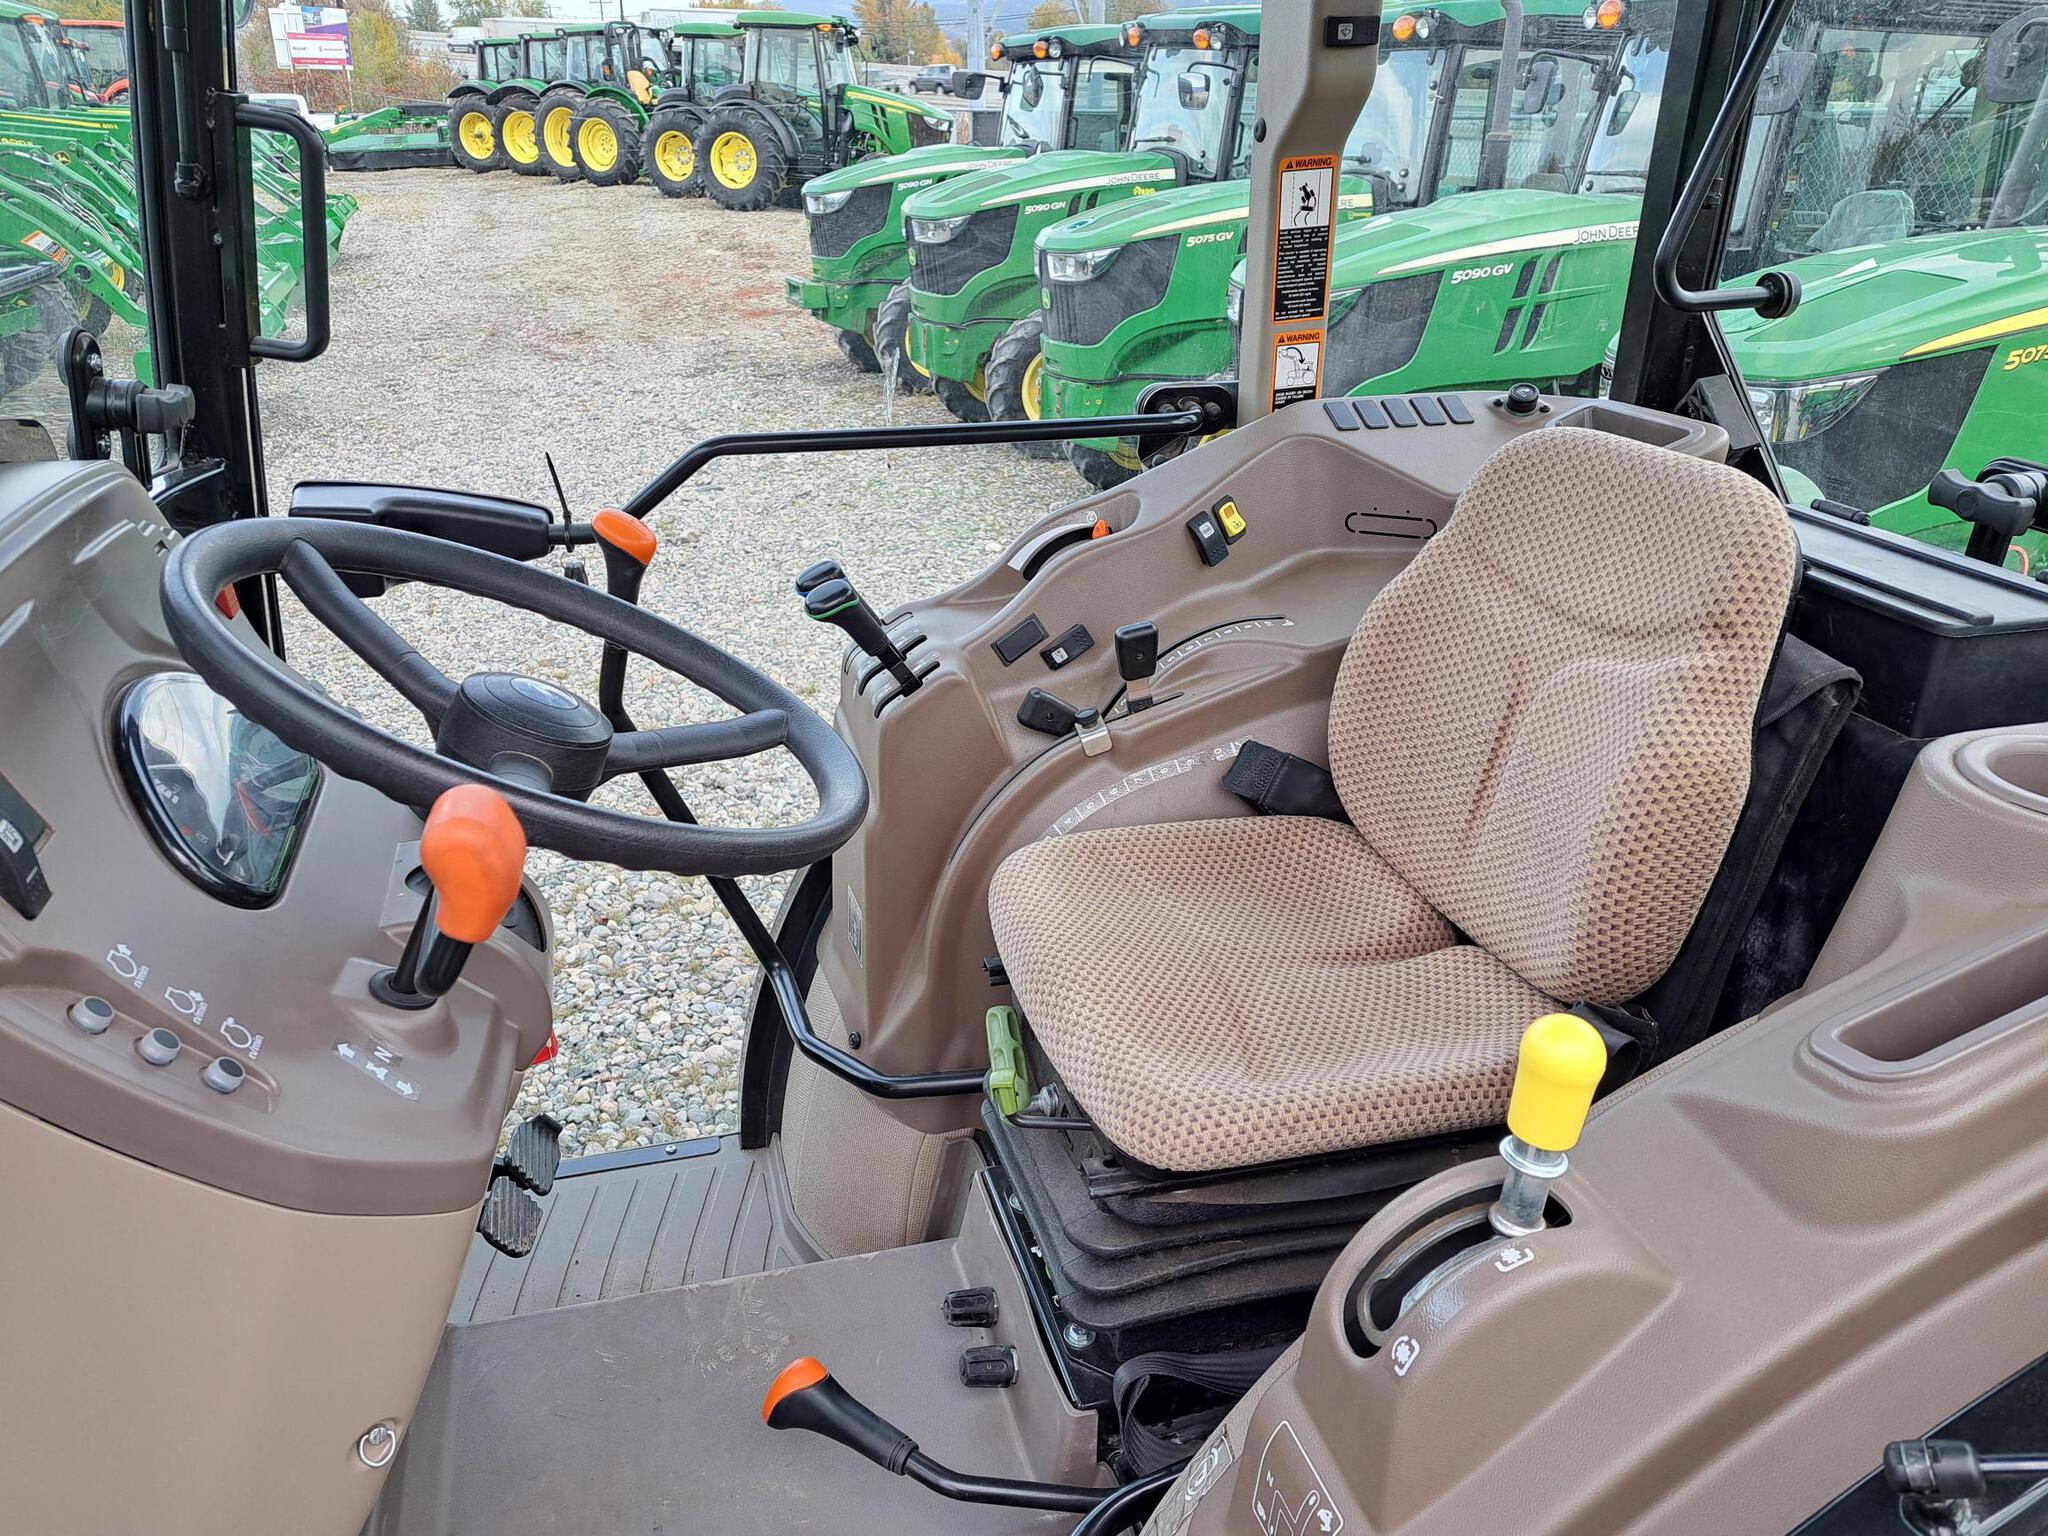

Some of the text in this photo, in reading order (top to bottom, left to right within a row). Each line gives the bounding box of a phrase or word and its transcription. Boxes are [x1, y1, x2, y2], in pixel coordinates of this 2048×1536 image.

[1295, 157, 1332, 168] WARNING
[1106, 172, 1160, 185] JOHN DEERE
[1575, 225, 1638, 244] JOHN DEER
[1450, 263, 1514, 284] 5090 GV
[1287, 333, 1319, 343] WARNING
[374, 1045, 393, 1064] N
